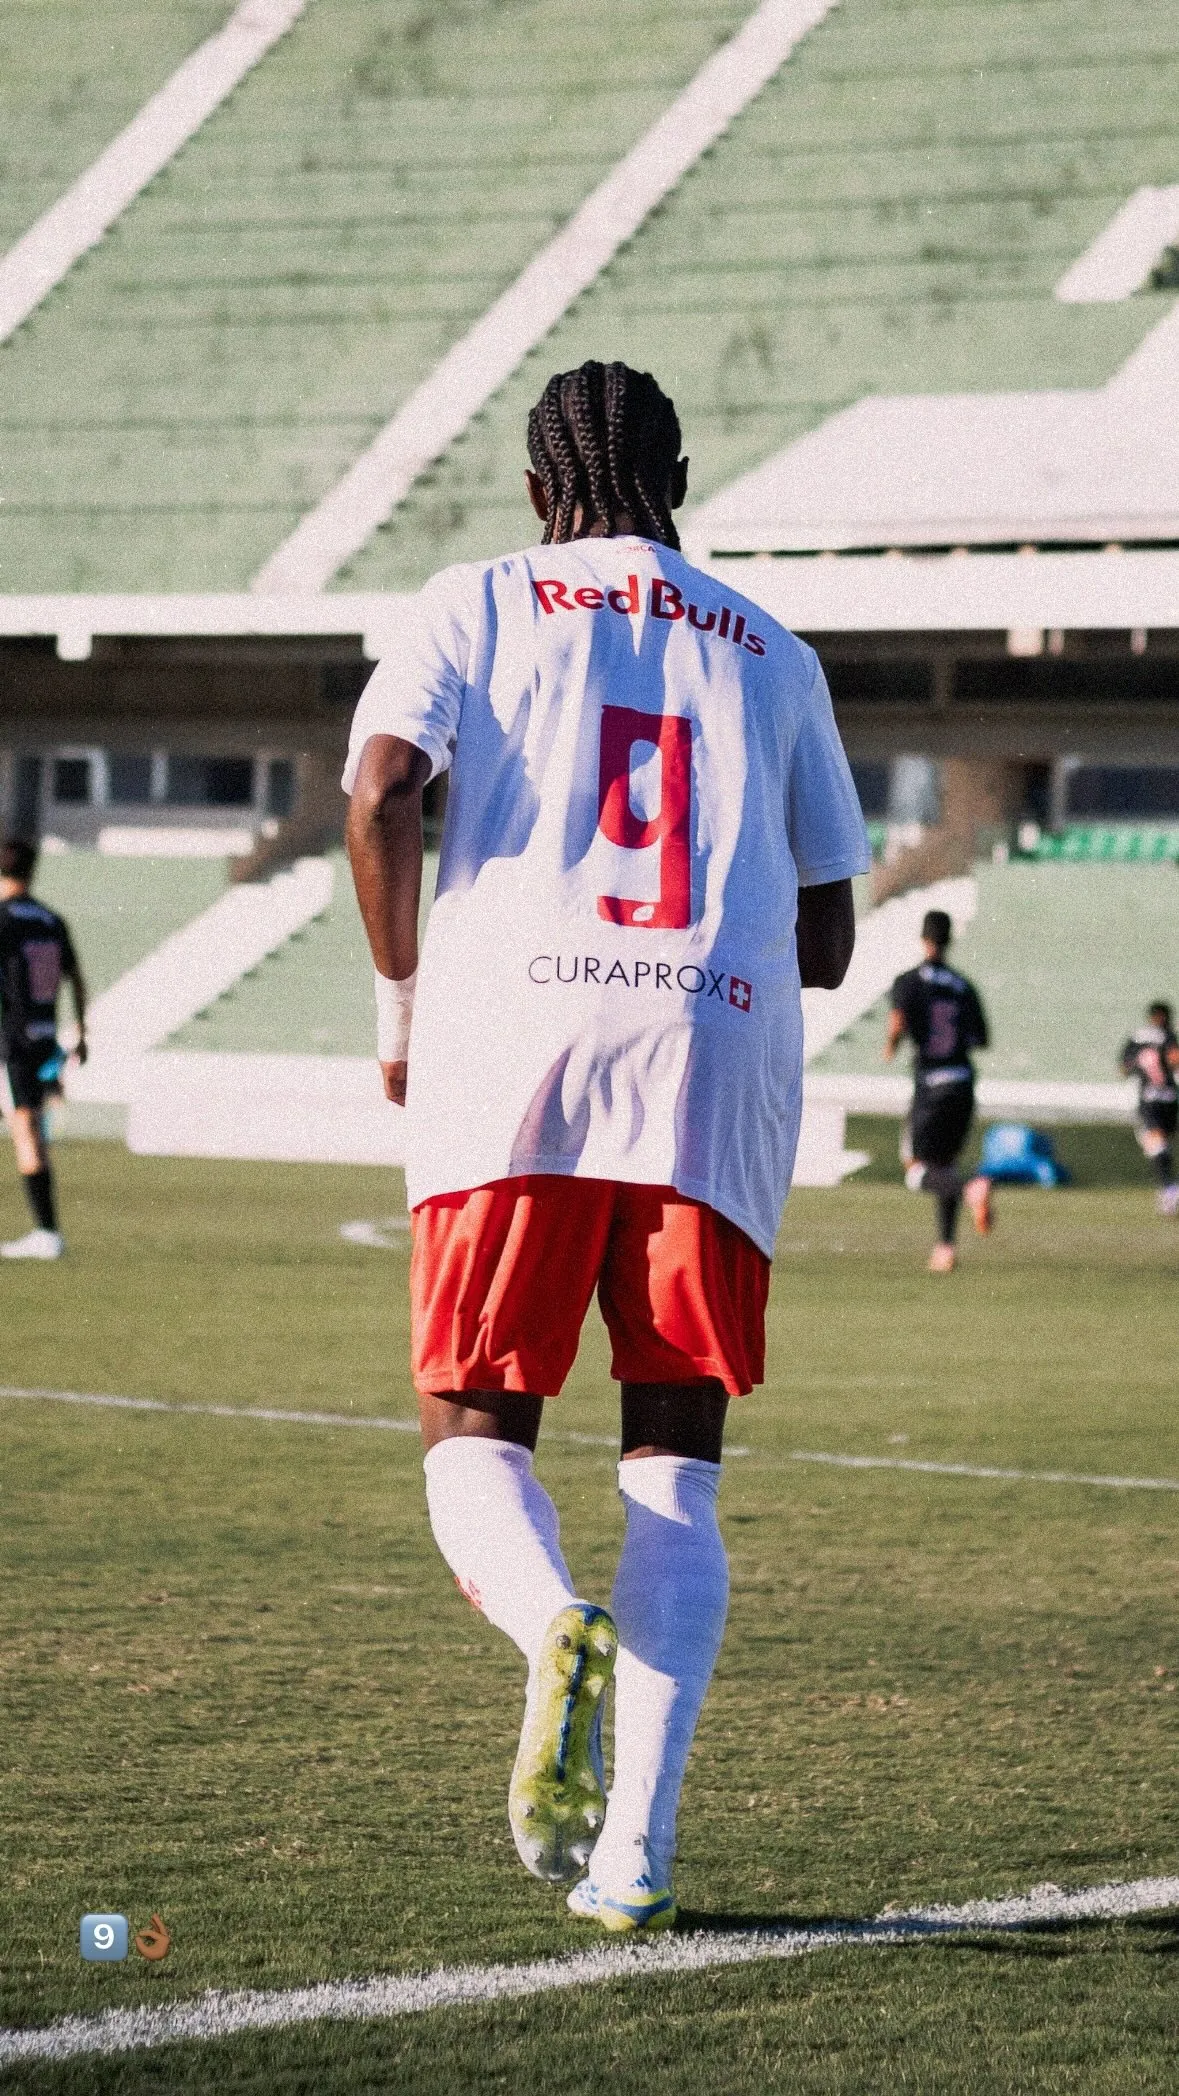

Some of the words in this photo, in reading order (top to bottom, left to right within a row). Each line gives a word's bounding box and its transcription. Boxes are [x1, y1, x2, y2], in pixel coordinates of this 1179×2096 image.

[531, 574, 640, 615] Red
[650, 577, 767, 657] Bulls
[597, 704, 693, 930] 9
[528, 955, 726, 1001] CURAPROX
